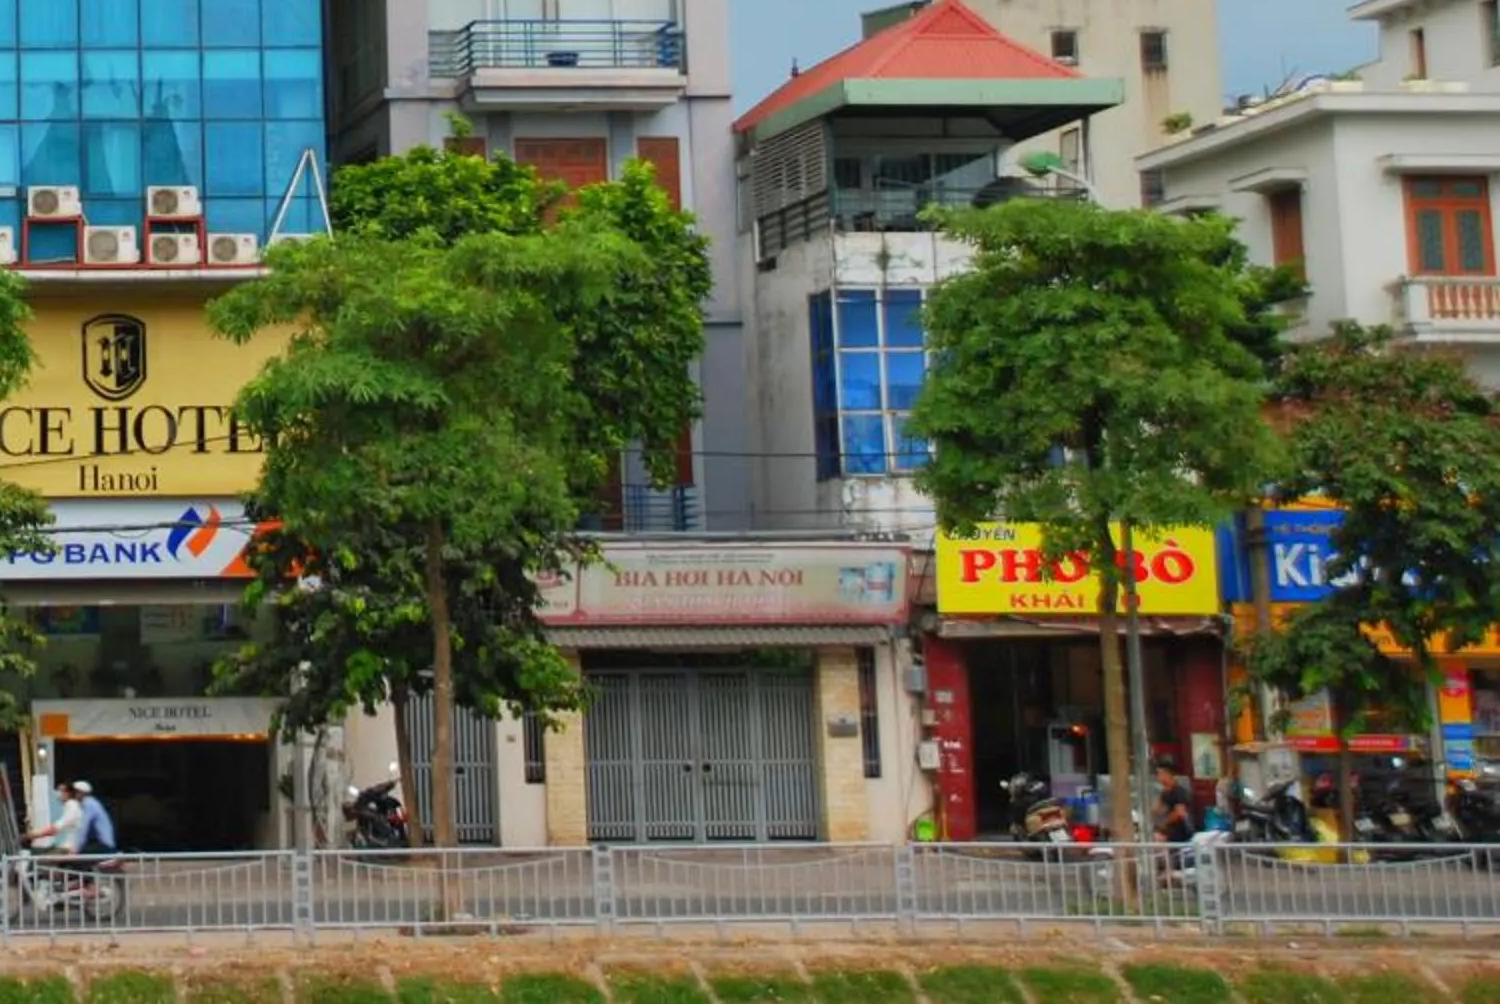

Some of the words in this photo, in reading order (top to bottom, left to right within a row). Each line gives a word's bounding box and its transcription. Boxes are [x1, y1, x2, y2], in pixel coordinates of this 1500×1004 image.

[87, 404, 263, 455] HOTE
[78, 465, 159, 492] Hanoi
[64, 543, 164, 564] BANK
[614, 570, 658, 587] BIA
